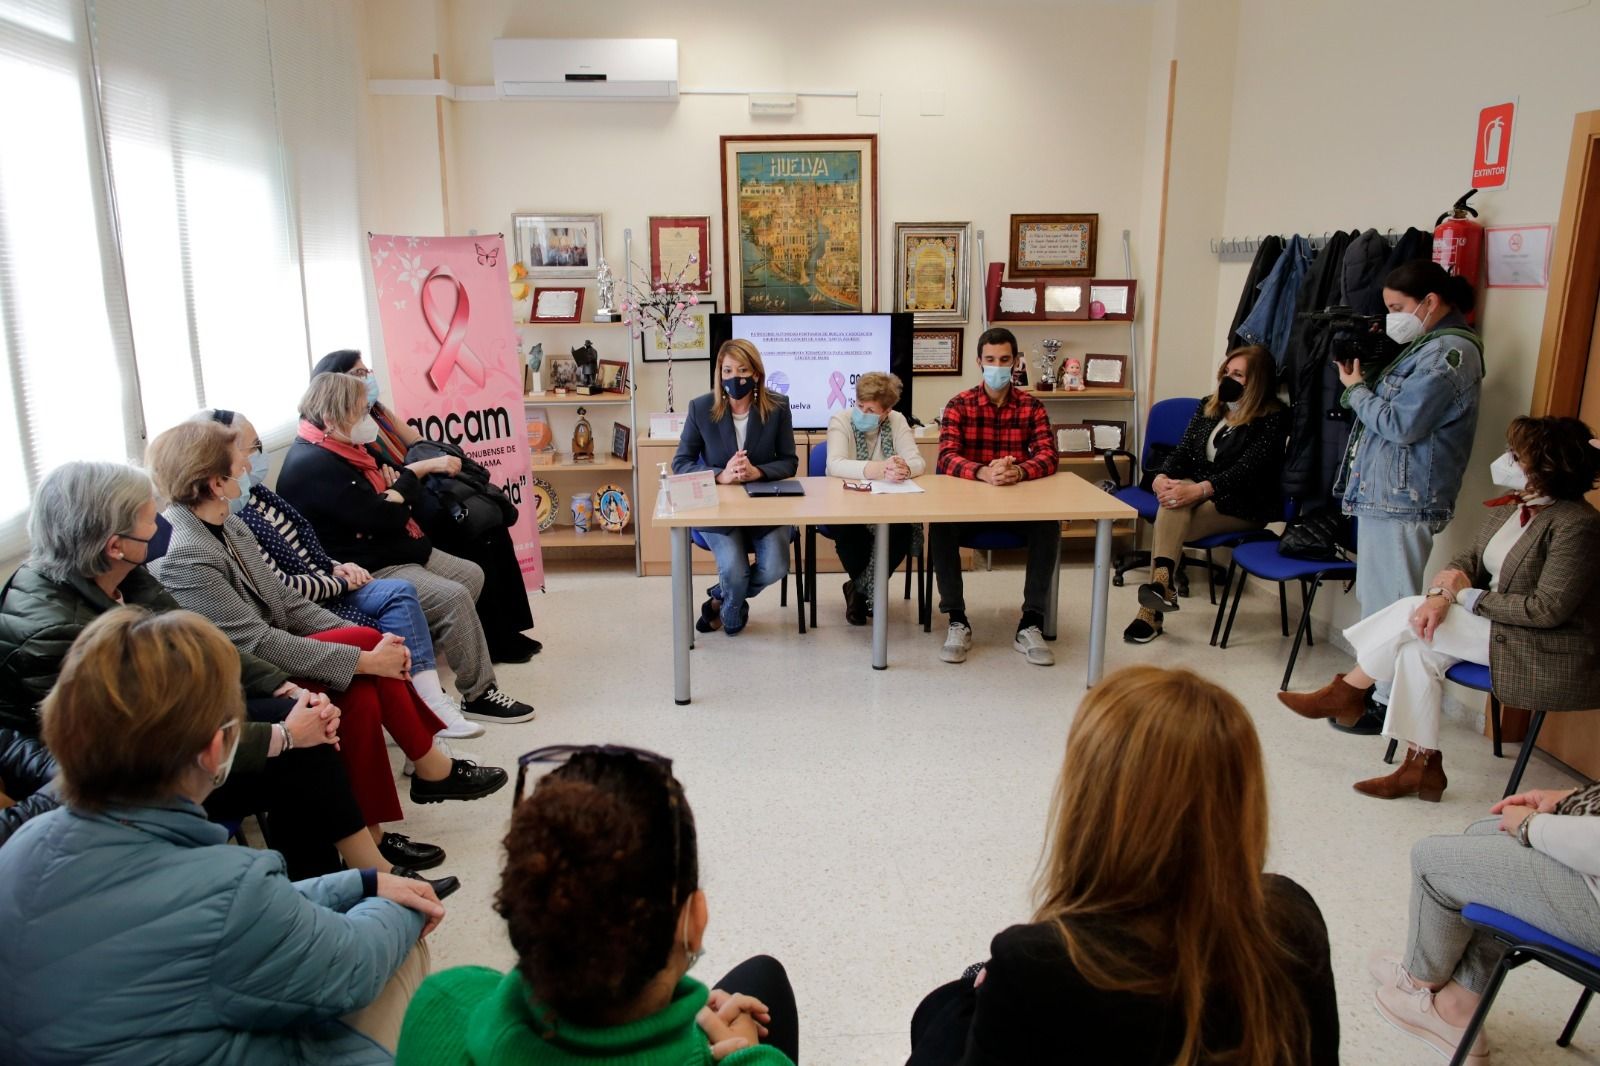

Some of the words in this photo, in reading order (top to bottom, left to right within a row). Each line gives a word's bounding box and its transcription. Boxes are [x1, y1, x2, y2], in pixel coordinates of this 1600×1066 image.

[770, 157, 829, 176] HUELVA
[1474, 167, 1505, 177] EXTINTOR
[466, 447, 505, 458] ONUBENSE
[507, 445, 516, 453] DE
